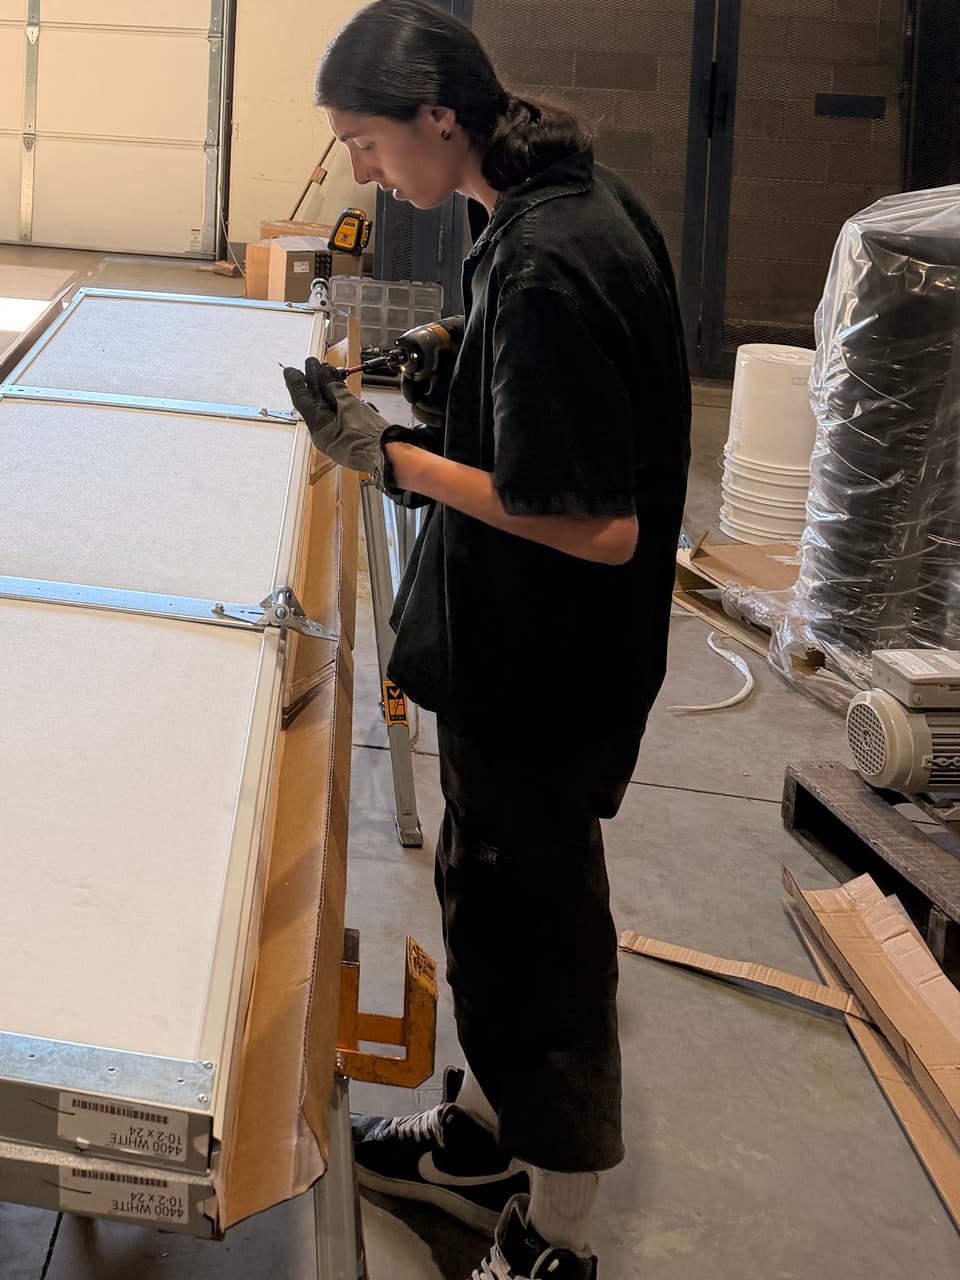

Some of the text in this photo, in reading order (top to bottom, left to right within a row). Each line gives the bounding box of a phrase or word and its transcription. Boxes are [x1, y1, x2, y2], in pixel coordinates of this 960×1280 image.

[129, 1126, 144, 1137] 24
[110, 1132, 183, 1156] 4400 WHITE
[156, 1131, 182, 1146] 10-2
[130, 1192, 145, 1203] 24
[158, 1196, 183, 1208] 10-2
[112, 1199, 184, 1219] 4400 WHITE
